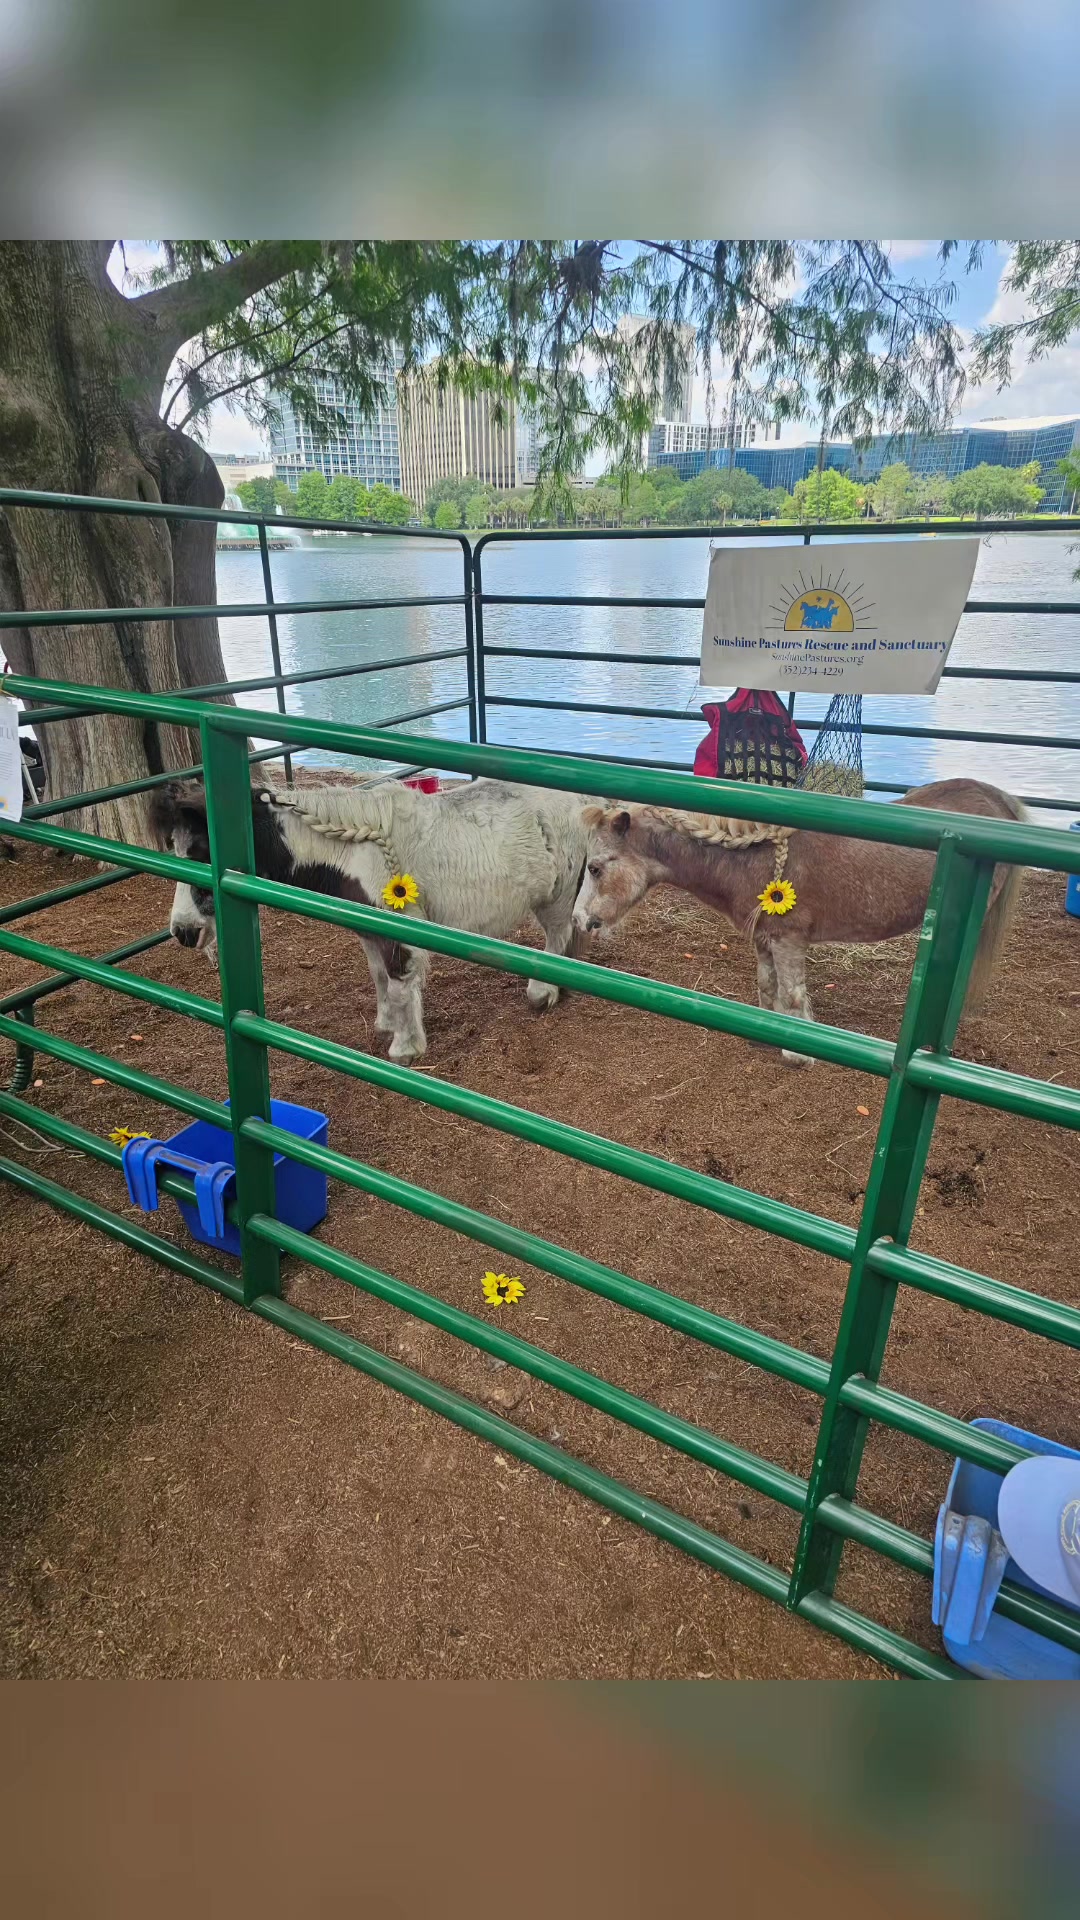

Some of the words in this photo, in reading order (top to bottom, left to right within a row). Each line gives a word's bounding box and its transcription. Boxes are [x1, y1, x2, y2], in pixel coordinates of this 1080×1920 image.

[713, 635, 757, 648] Sunshine
[759, 637, 802, 649] Pastures
[804, 638, 849, 651] Rescue
[851, 638, 877, 651] and
[879, 639, 948, 653] Sanctuary
[771, 652, 865, 666] SunshinePastures.org
[779, 665, 844, 677] (352)234-4229
